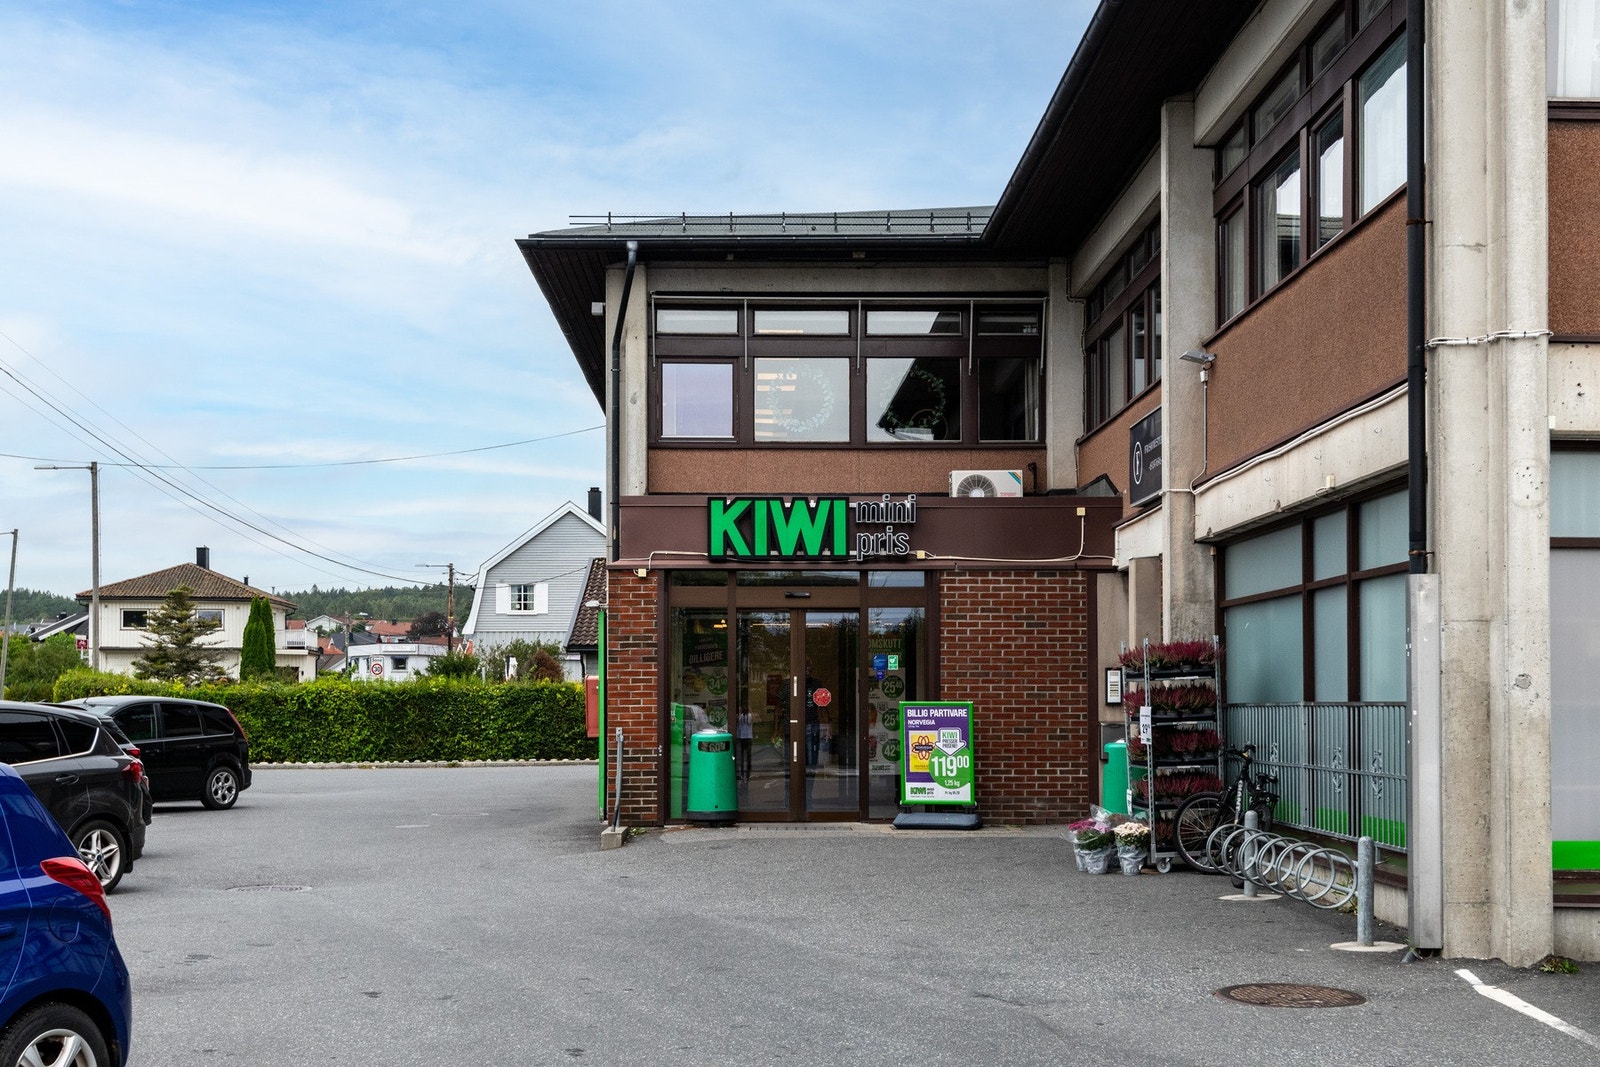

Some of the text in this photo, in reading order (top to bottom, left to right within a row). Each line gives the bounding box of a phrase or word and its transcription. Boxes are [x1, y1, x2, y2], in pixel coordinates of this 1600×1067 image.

[709, 494, 917, 557] KIWI mini
[856, 526, 910, 561] pris
[688, 650, 724, 664] BILLIGERE
[907, 708, 968, 717] BILLIG PARTIVARE
[1235, 780, 1244, 811] GIANT
